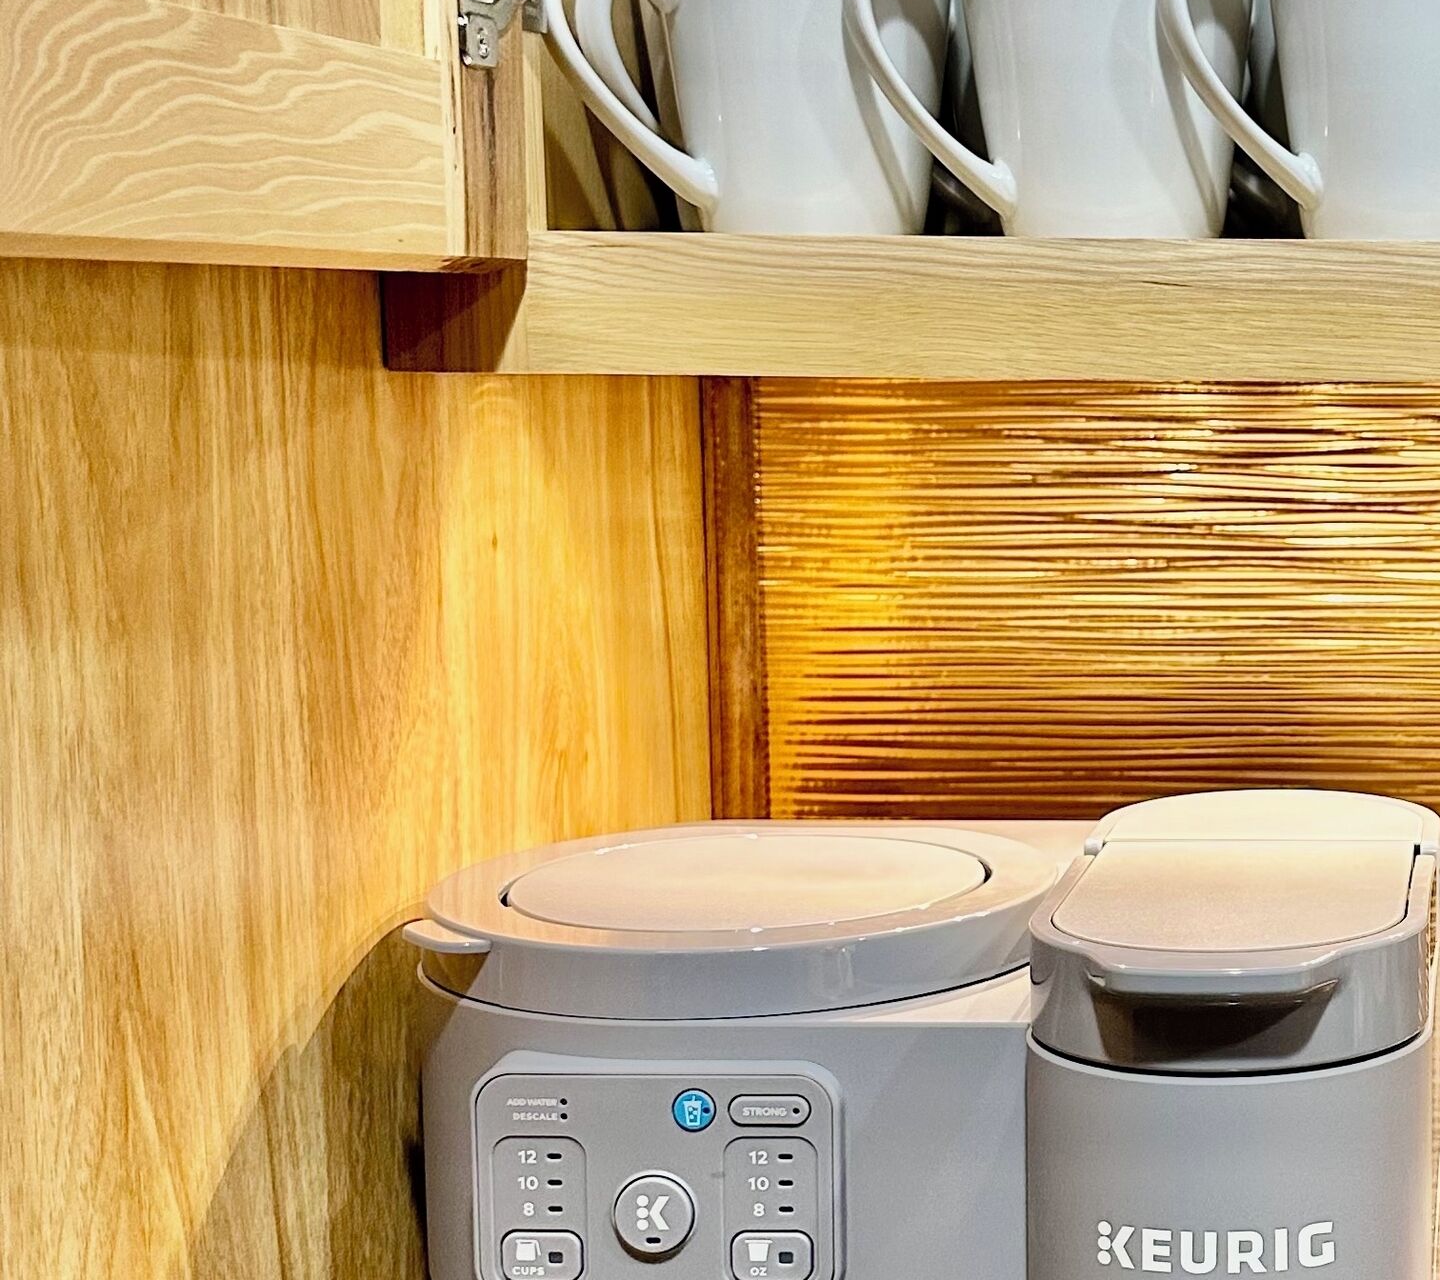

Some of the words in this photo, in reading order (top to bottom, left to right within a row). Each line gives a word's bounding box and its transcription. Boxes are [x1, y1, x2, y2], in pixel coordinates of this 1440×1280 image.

[507, 1097, 526, 1107] ADD
[527, 1097, 558, 1107] WATER
[512, 1112, 558, 1121] DESCALE
[742, 1106, 787, 1118] STRONG
[518, 1150, 537, 1165] 12
[748, 1150, 769, 1166] 12
[518, 1176, 539, 1191] 10
[748, 1176, 770, 1191] 10
[523, 1202, 535, 1217] 8
[753, 1202, 766, 1217] 8
[1097, 1220, 1336, 1275] KEURIG
[512, 1265, 545, 1276] CUPS
[749, 1265, 768, 1276] OZ
